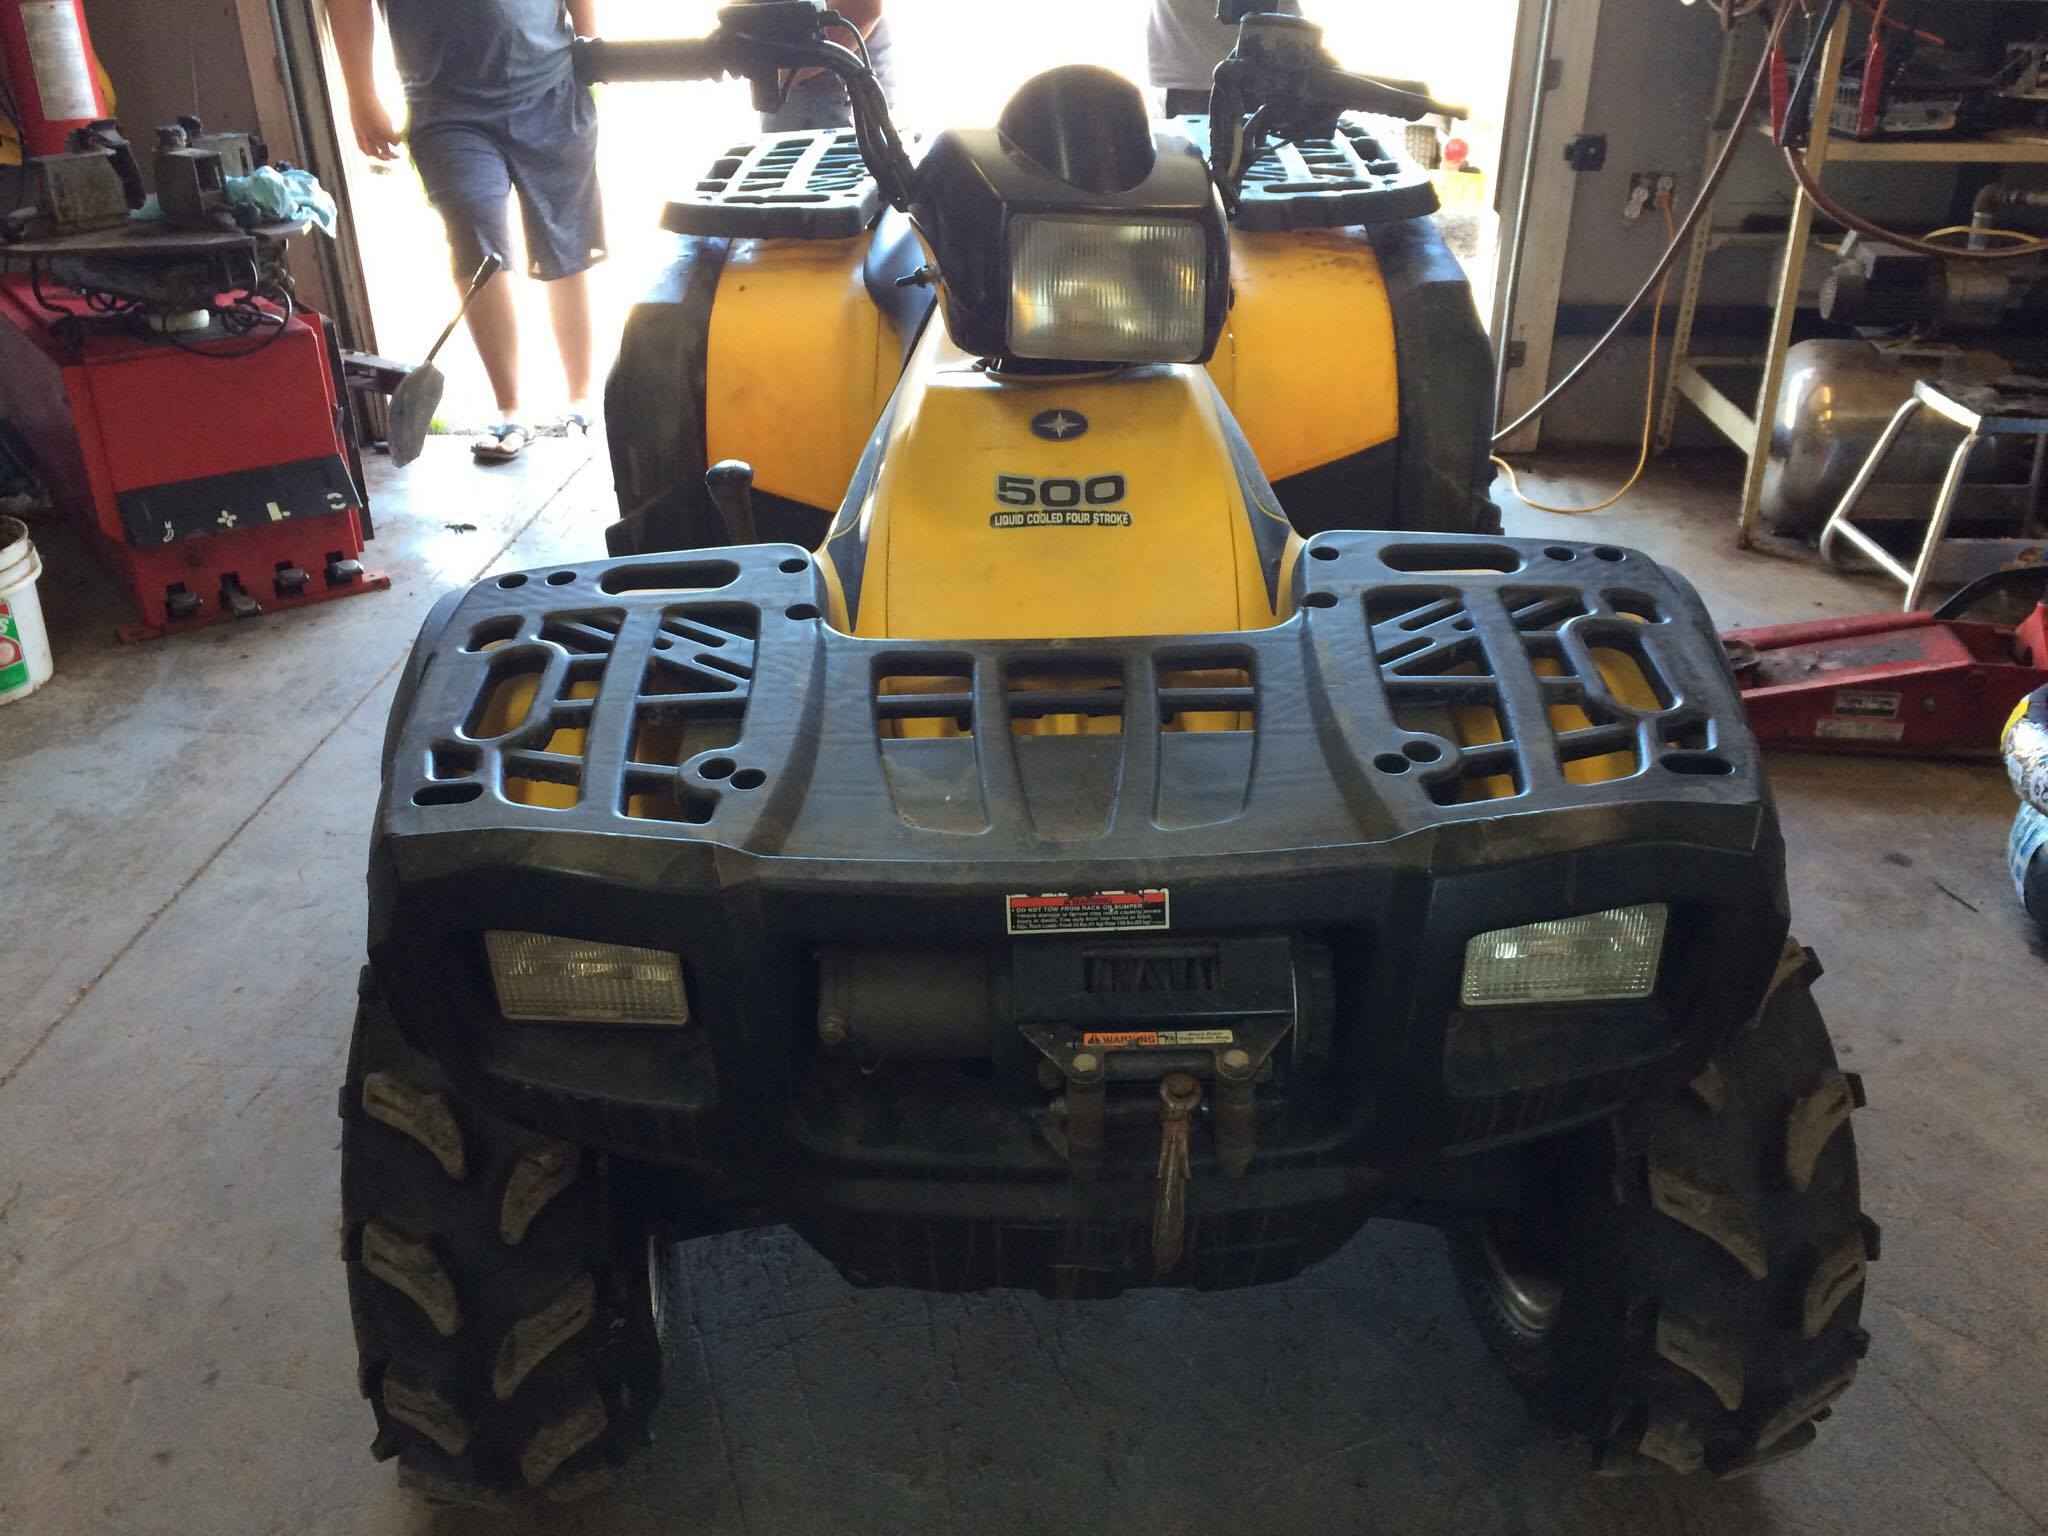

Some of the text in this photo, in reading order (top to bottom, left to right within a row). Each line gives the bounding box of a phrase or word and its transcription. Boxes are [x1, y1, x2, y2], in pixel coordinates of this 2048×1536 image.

[997, 475, 1125, 507] 500
[994, 512, 1129, 526] LIQUID COOLED FOUR STROKE
